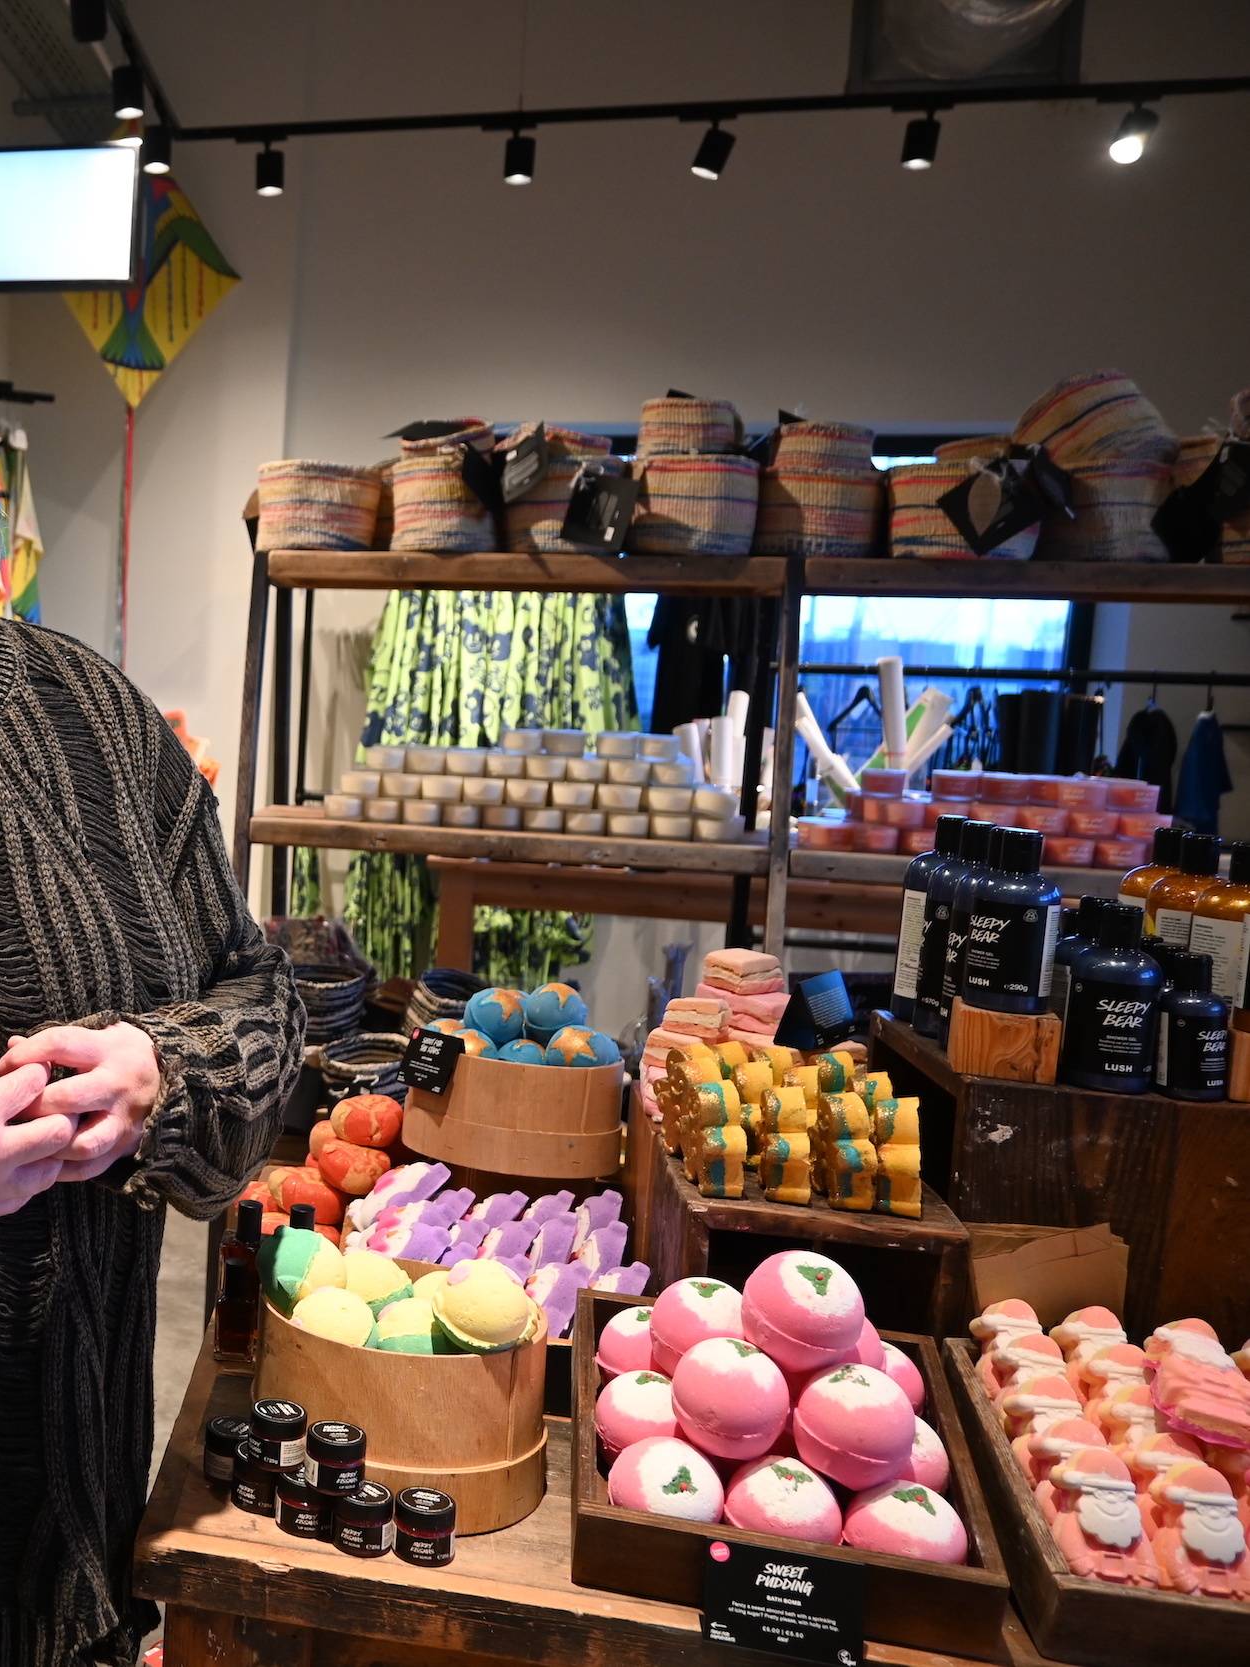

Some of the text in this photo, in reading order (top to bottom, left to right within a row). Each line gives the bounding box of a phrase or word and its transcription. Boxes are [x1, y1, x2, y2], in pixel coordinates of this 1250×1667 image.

[969, 914, 1011, 931] SLEEPY
[969, 929, 1001, 944] BEAR
[968, 975, 990, 987] LUSH
[1096, 999, 1152, 1015] SLEEPY
[1102, 1014, 1143, 1028] BEAR
[1202, 1041, 1227, 1053] BEAR
[1104, 1062, 1134, 1073] LUSH
[1206, 1079, 1224, 1087] LUSH
[762, 1562, 810, 1579] SWEET
[755, 1574, 815, 1597] PUDDING
[765, 1595, 802, 1606] BATH BOMB
